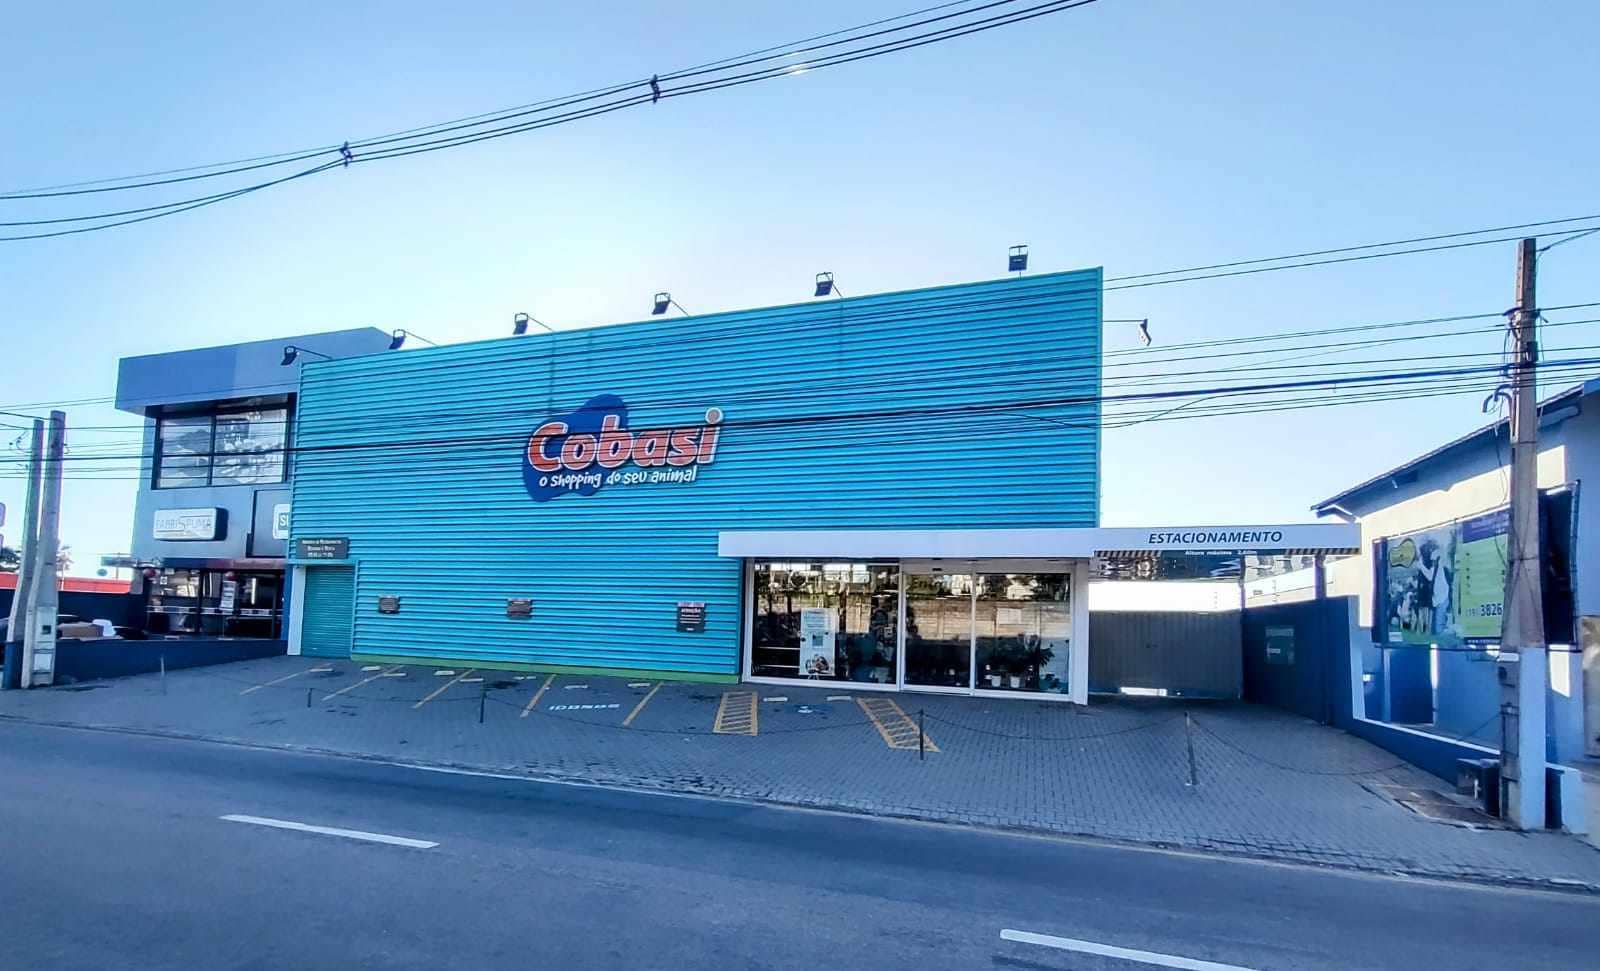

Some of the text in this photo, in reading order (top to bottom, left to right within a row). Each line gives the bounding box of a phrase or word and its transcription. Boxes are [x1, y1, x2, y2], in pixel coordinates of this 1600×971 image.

[528, 407, 723, 472] Cobasi
[539, 465, 697, 490] o shopping do seu animal
[1148, 531, 1282, 544] ESTACIONAMENTO
